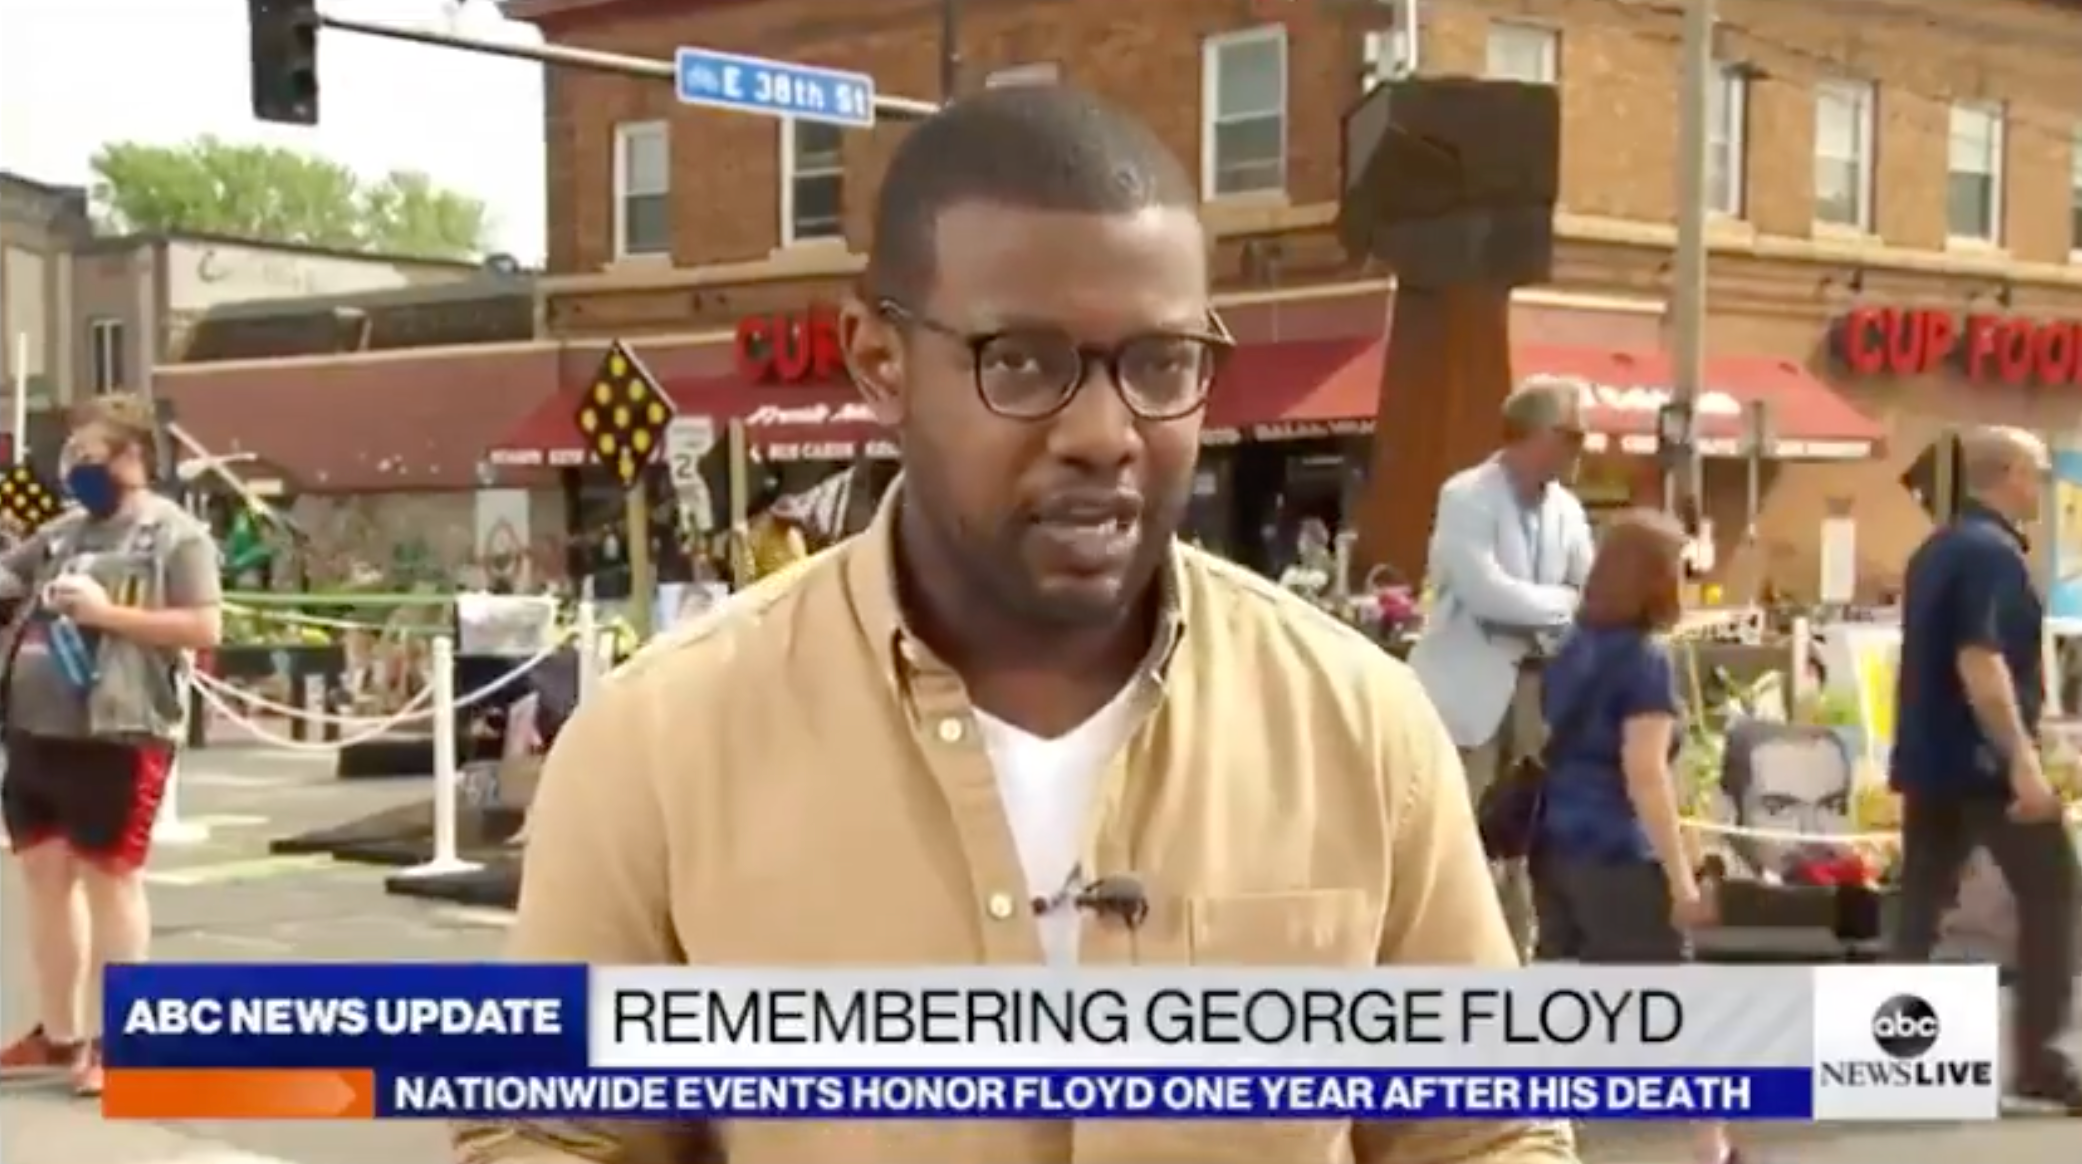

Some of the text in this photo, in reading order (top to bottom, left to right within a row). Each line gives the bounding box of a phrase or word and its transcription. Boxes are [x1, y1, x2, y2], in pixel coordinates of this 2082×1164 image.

[723, 66, 865, 116] E 38th St
[1846, 306, 2082, 385] CUP FOO
